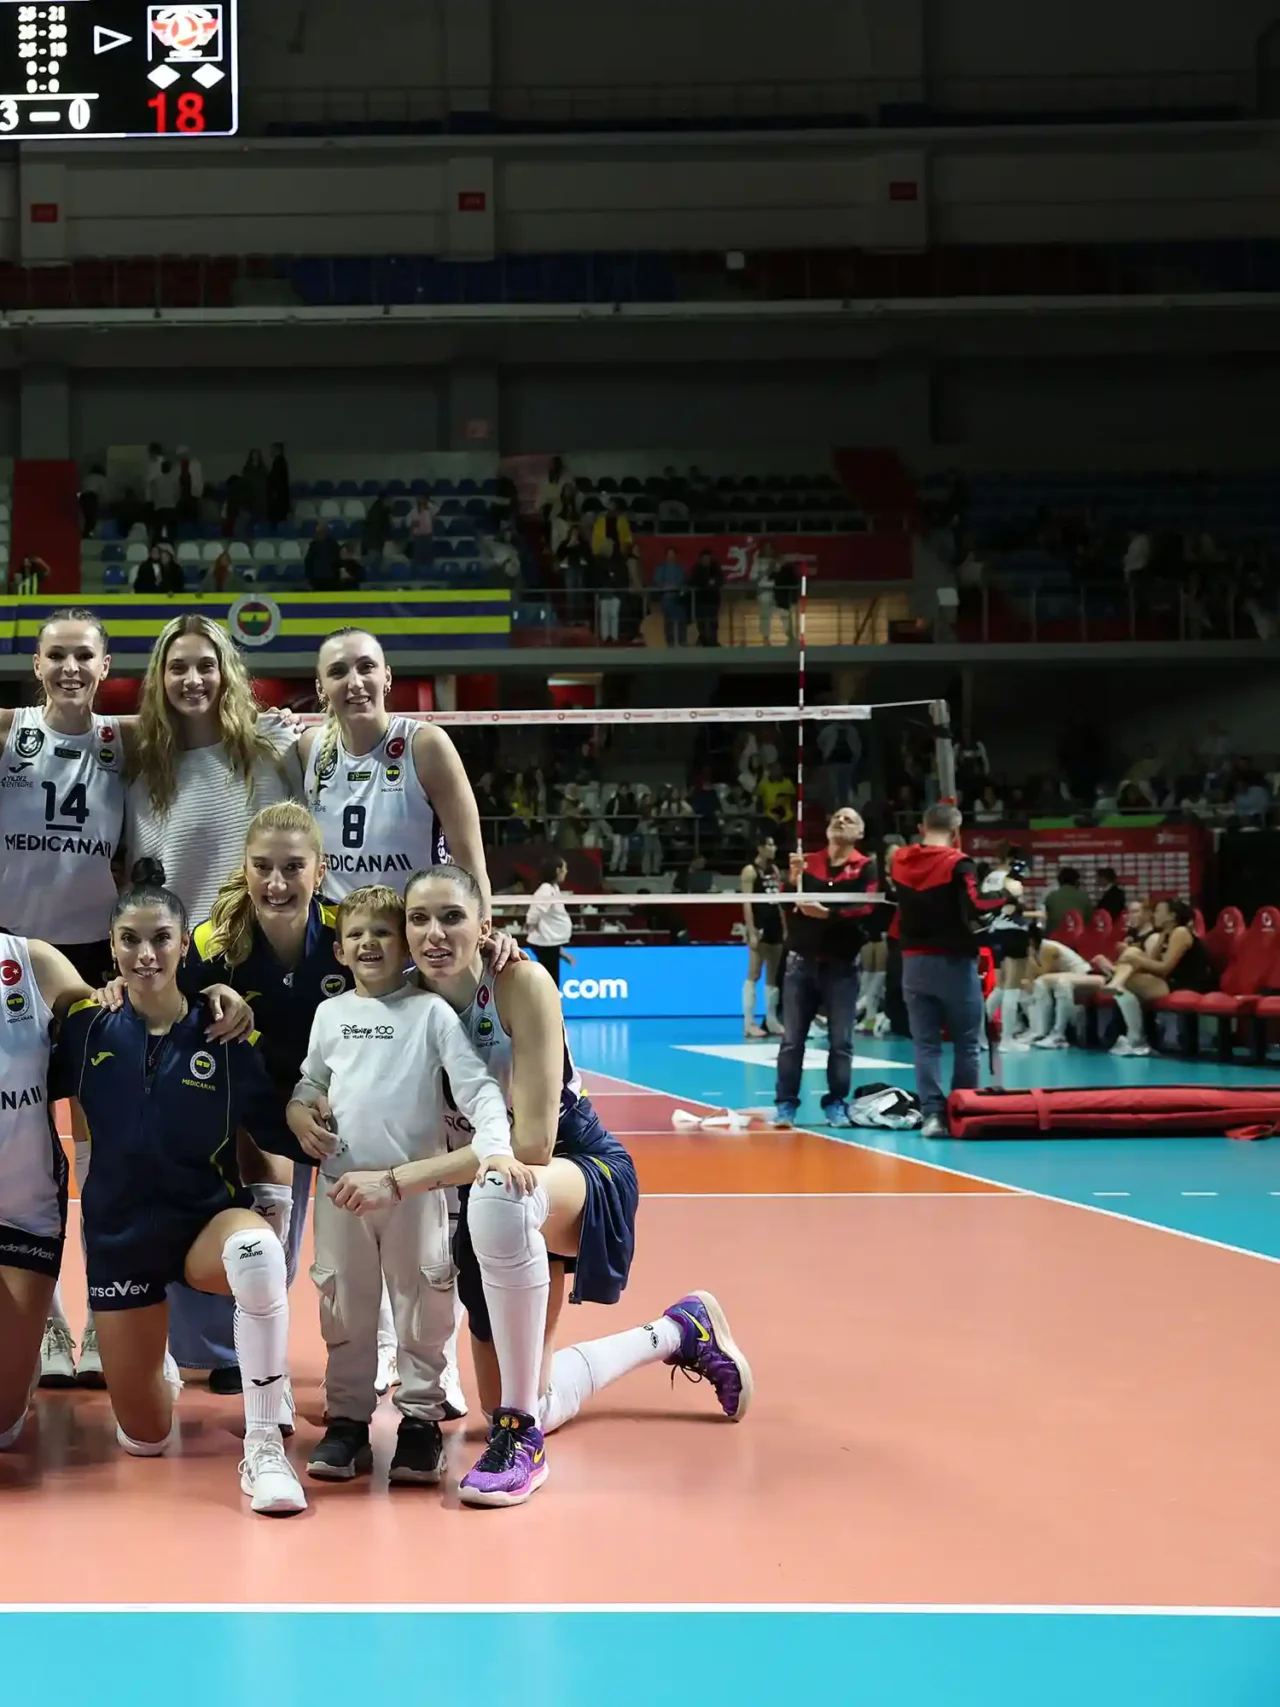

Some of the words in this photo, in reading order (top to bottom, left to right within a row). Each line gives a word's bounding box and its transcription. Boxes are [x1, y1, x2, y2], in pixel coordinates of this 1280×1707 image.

[147, 93, 204, 133] 18
[41, 780, 90, 824] 14
[342, 805, 366, 849] 8
[374, 1025, 395, 1035] 100
